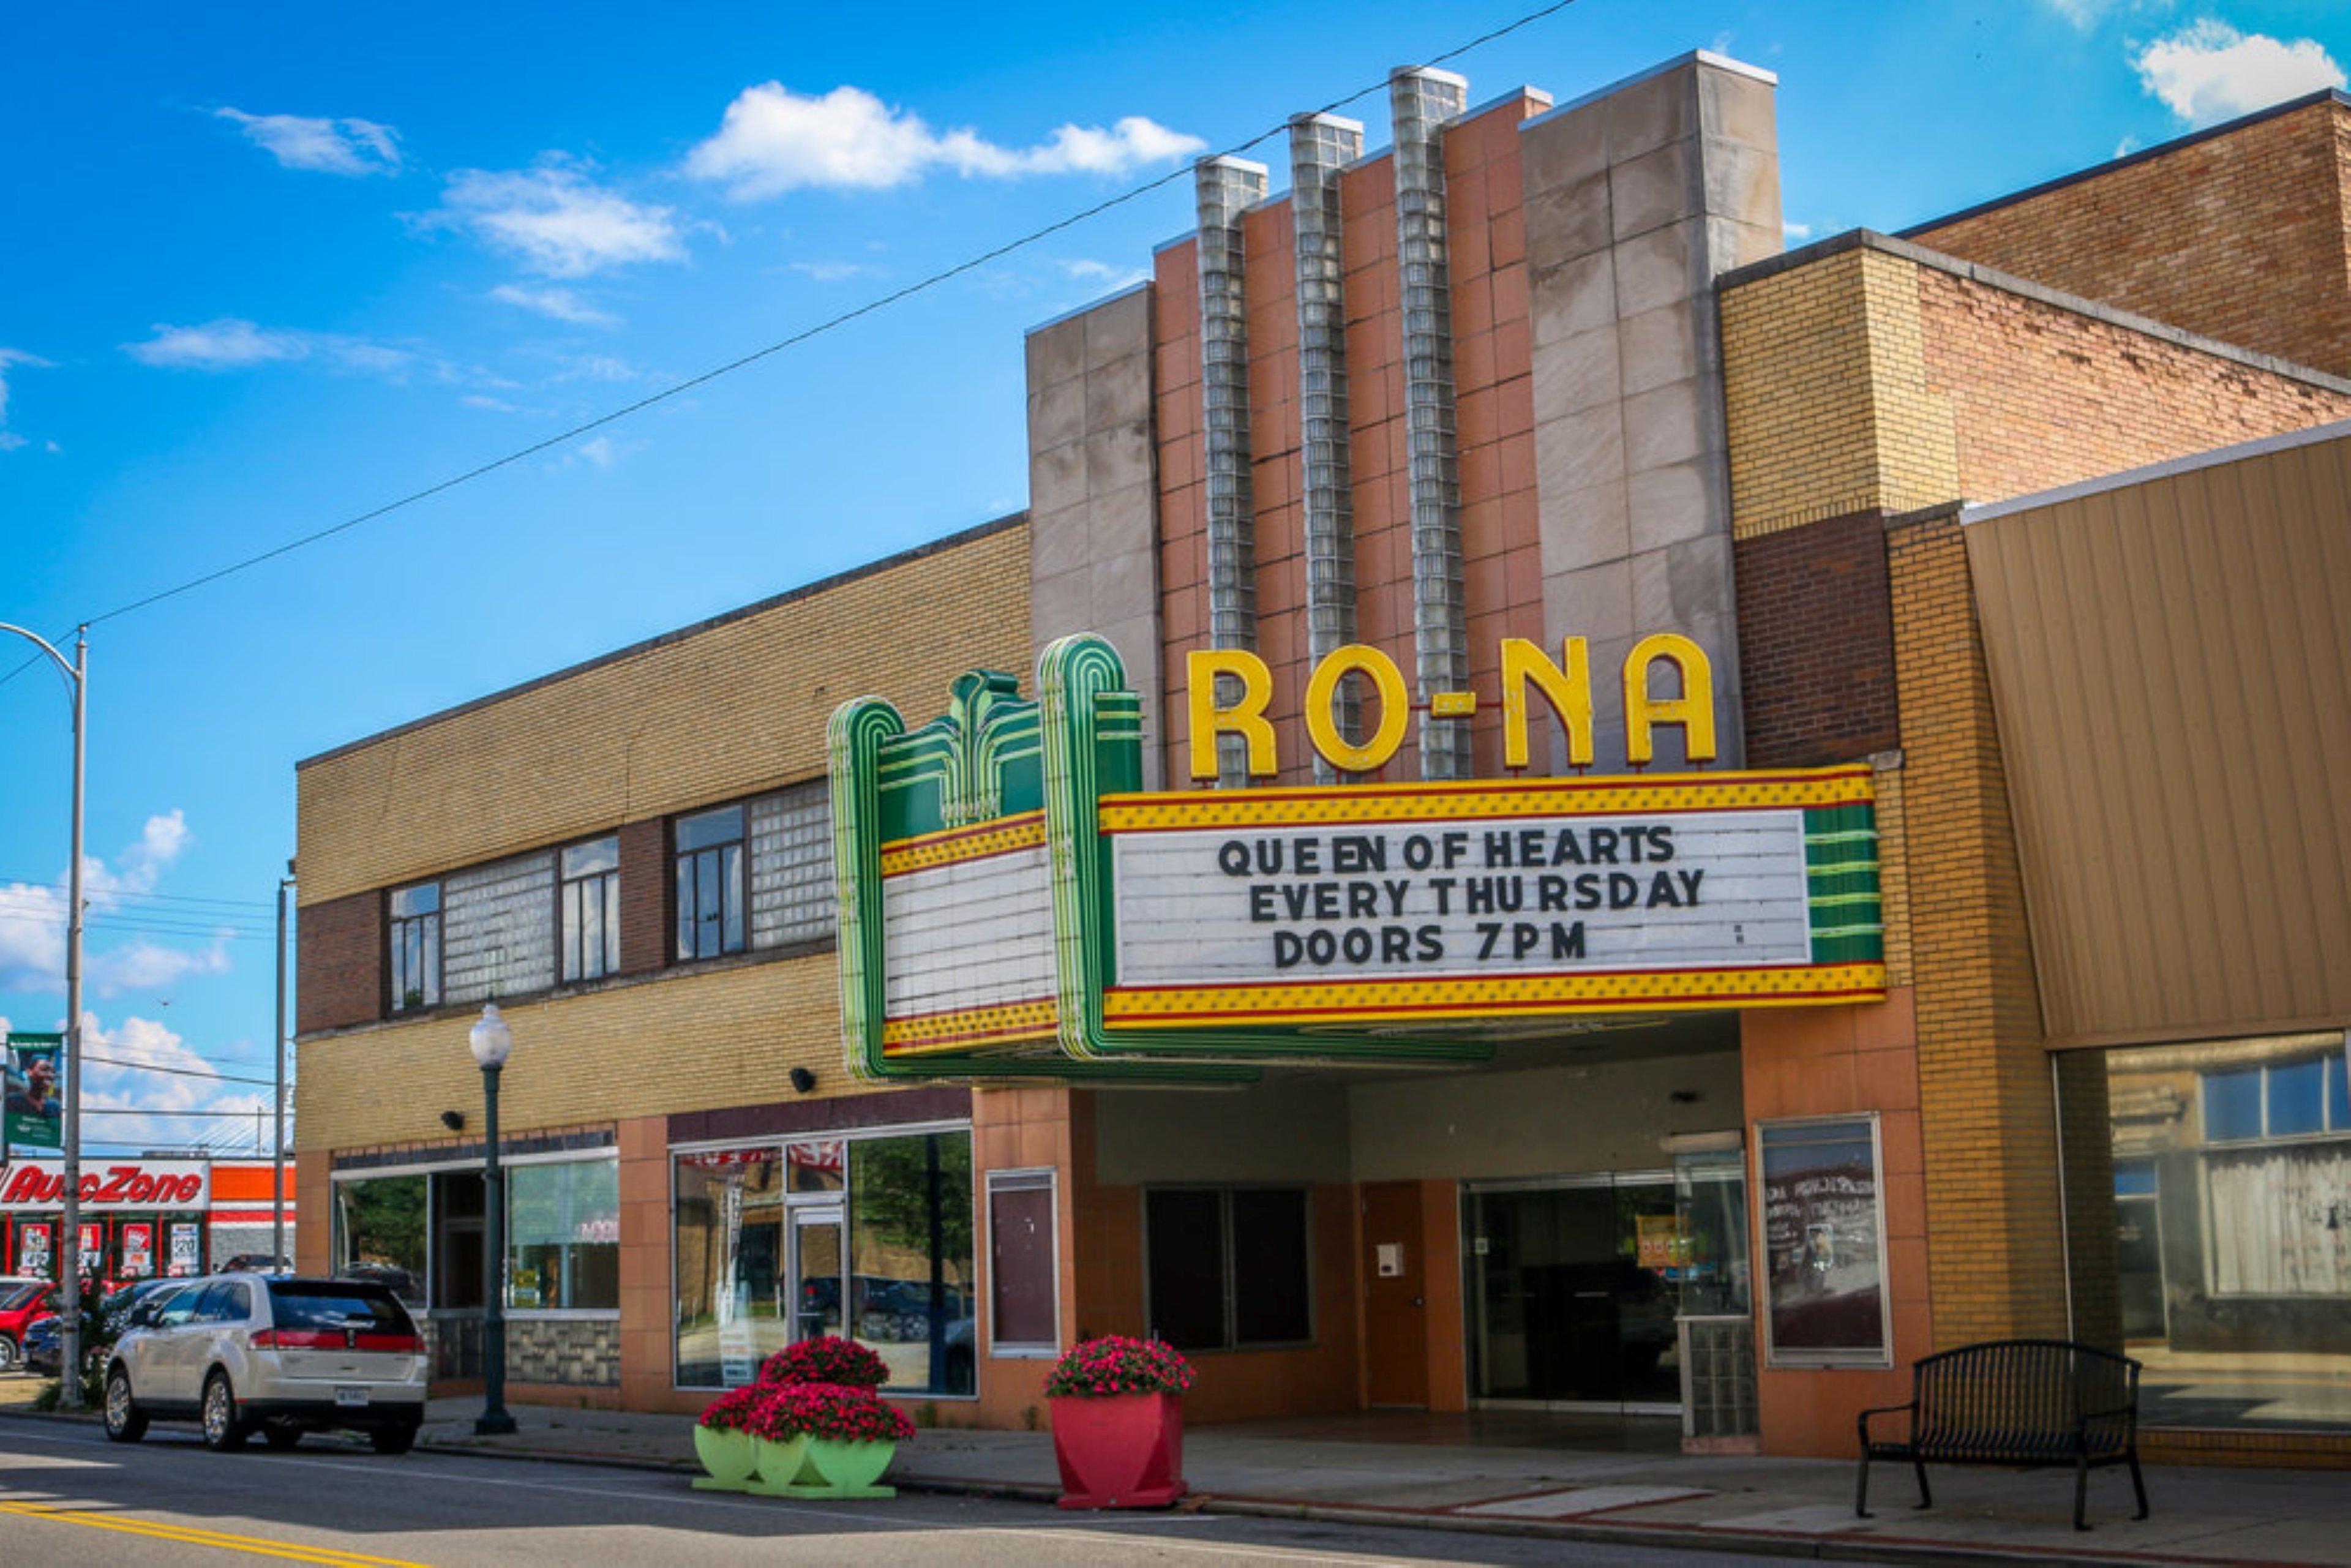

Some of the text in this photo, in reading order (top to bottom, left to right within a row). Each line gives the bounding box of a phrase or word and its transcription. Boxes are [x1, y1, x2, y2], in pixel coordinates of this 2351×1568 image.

[1187, 633, 1715, 780] RO-NA
[1218, 826, 1674, 876] QUEEN OF HEARTS
[1250, 869, 1704, 922] EVERY THURSDAY
[1273, 921, 1585, 968] DOORS 7PM
[1, 1165, 203, 1202] AuoZone
